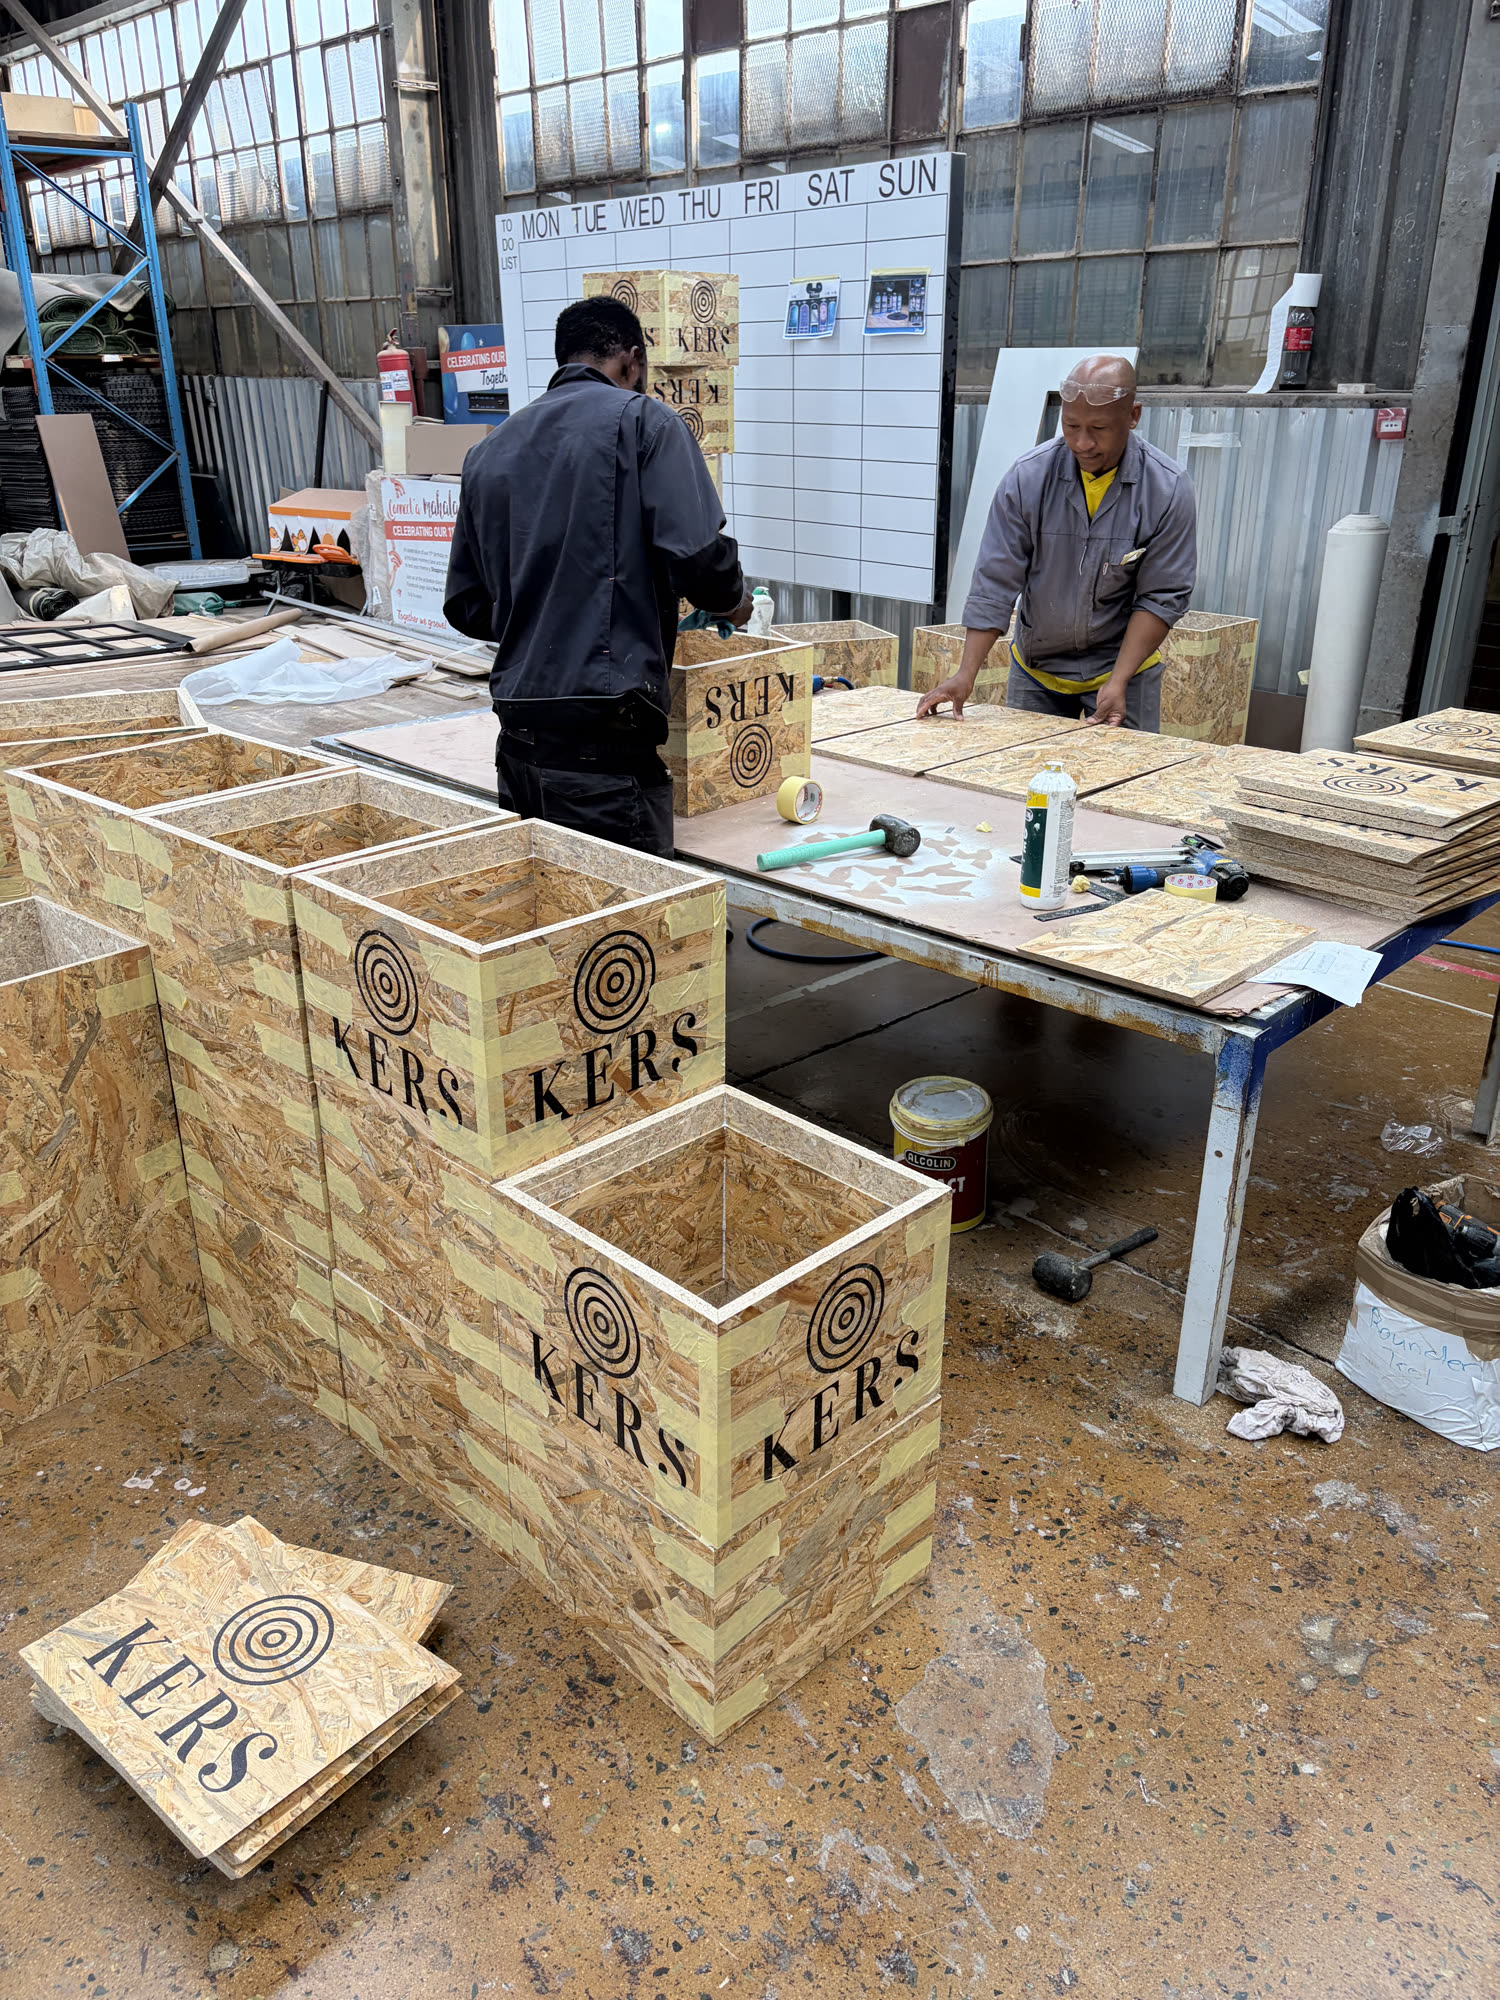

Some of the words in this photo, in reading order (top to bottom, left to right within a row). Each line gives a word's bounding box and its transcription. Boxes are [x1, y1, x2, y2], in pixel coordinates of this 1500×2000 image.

[522, 209, 560, 241] MON
[571, 203, 608, 234] TUE
[619, 196, 665, 229] WED
[678, 187, 722, 222] THU
[744, 179, 780, 215] FRI
[807, 168, 856, 207] SAT
[878, 156, 937, 199] SUN
[501, 218, 513, 233] TO
[501, 237, 515, 252] DO
[501, 255, 518, 271] LIST
[677, 325, 731, 354] KERS
[446, 352, 491, 369] CELEBRATING
[490, 350, 506, 364] OUR
[653, 378, 720, 405] KERS
[392, 525, 433, 538] CELEBRATING
[433, 526, 447, 538] OUR
[705, 672, 795, 729] KERS
[1317, 756, 1488, 792] KERS
[332, 1015, 464, 1133] KERS
[528, 1012, 698, 1133] KERS
[907, 1152, 951, 1169] ALCOLIN
[529, 1327, 687, 1489] KERS
[763, 1329, 919, 1482] KERS
[82, 1617, 278, 1793] KERS
